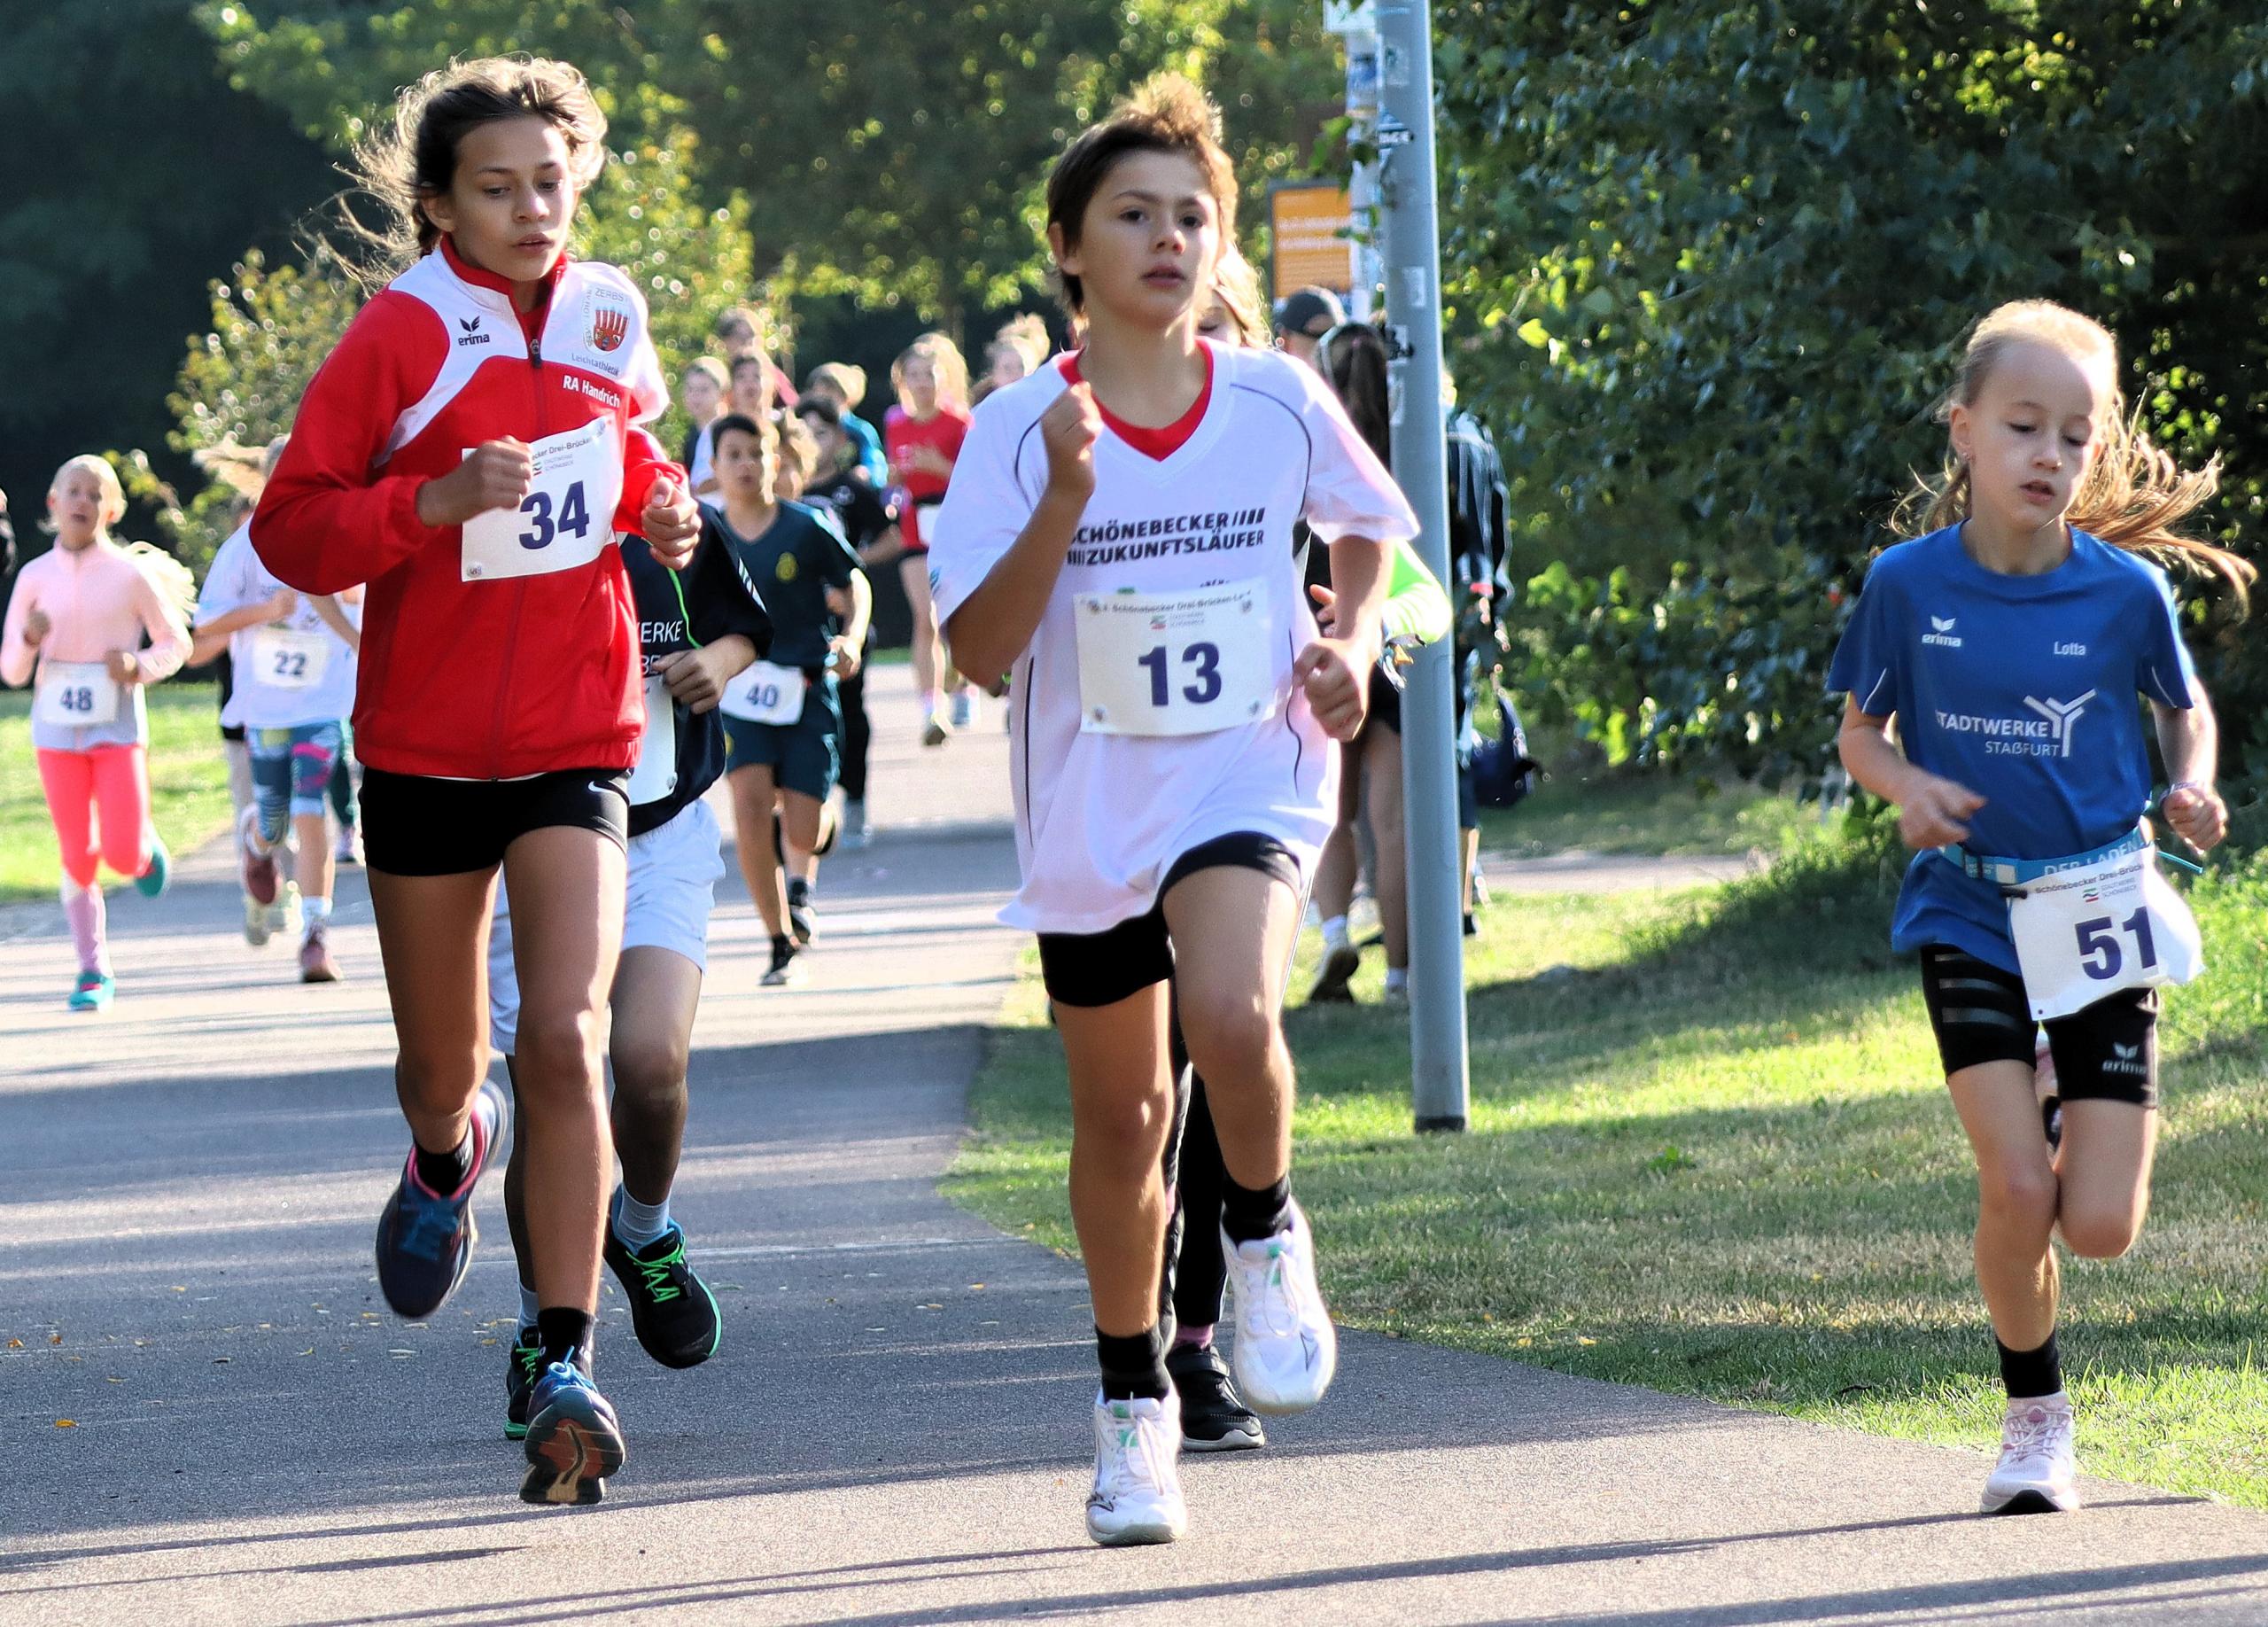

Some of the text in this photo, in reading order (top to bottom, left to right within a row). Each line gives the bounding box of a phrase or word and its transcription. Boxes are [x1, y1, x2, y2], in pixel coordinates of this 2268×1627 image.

[458, 333, 490, 346] erima
[571, 353, 619, 377] Leichtathletik
[563, 375, 620, 409] RA Handrich
[519, 480, 590, 550] 34
[1070, 512, 1228, 545] CHÖNEBECKER
[1086, 526, 1264, 565] ZUKUNFTSLÄUFER
[637, 620, 683, 643] ERKE
[1922, 633, 1962, 648] erima
[2054, 641, 2086, 656] Lotta
[274, 650, 307, 678] 22
[1138, 642, 1222, 706] 13
[59, 686, 94, 712] 48
[746, 682, 780, 708] 40
[2074, 906, 2156, 980] 51
[2102, 1059, 2147, 1075] erima
